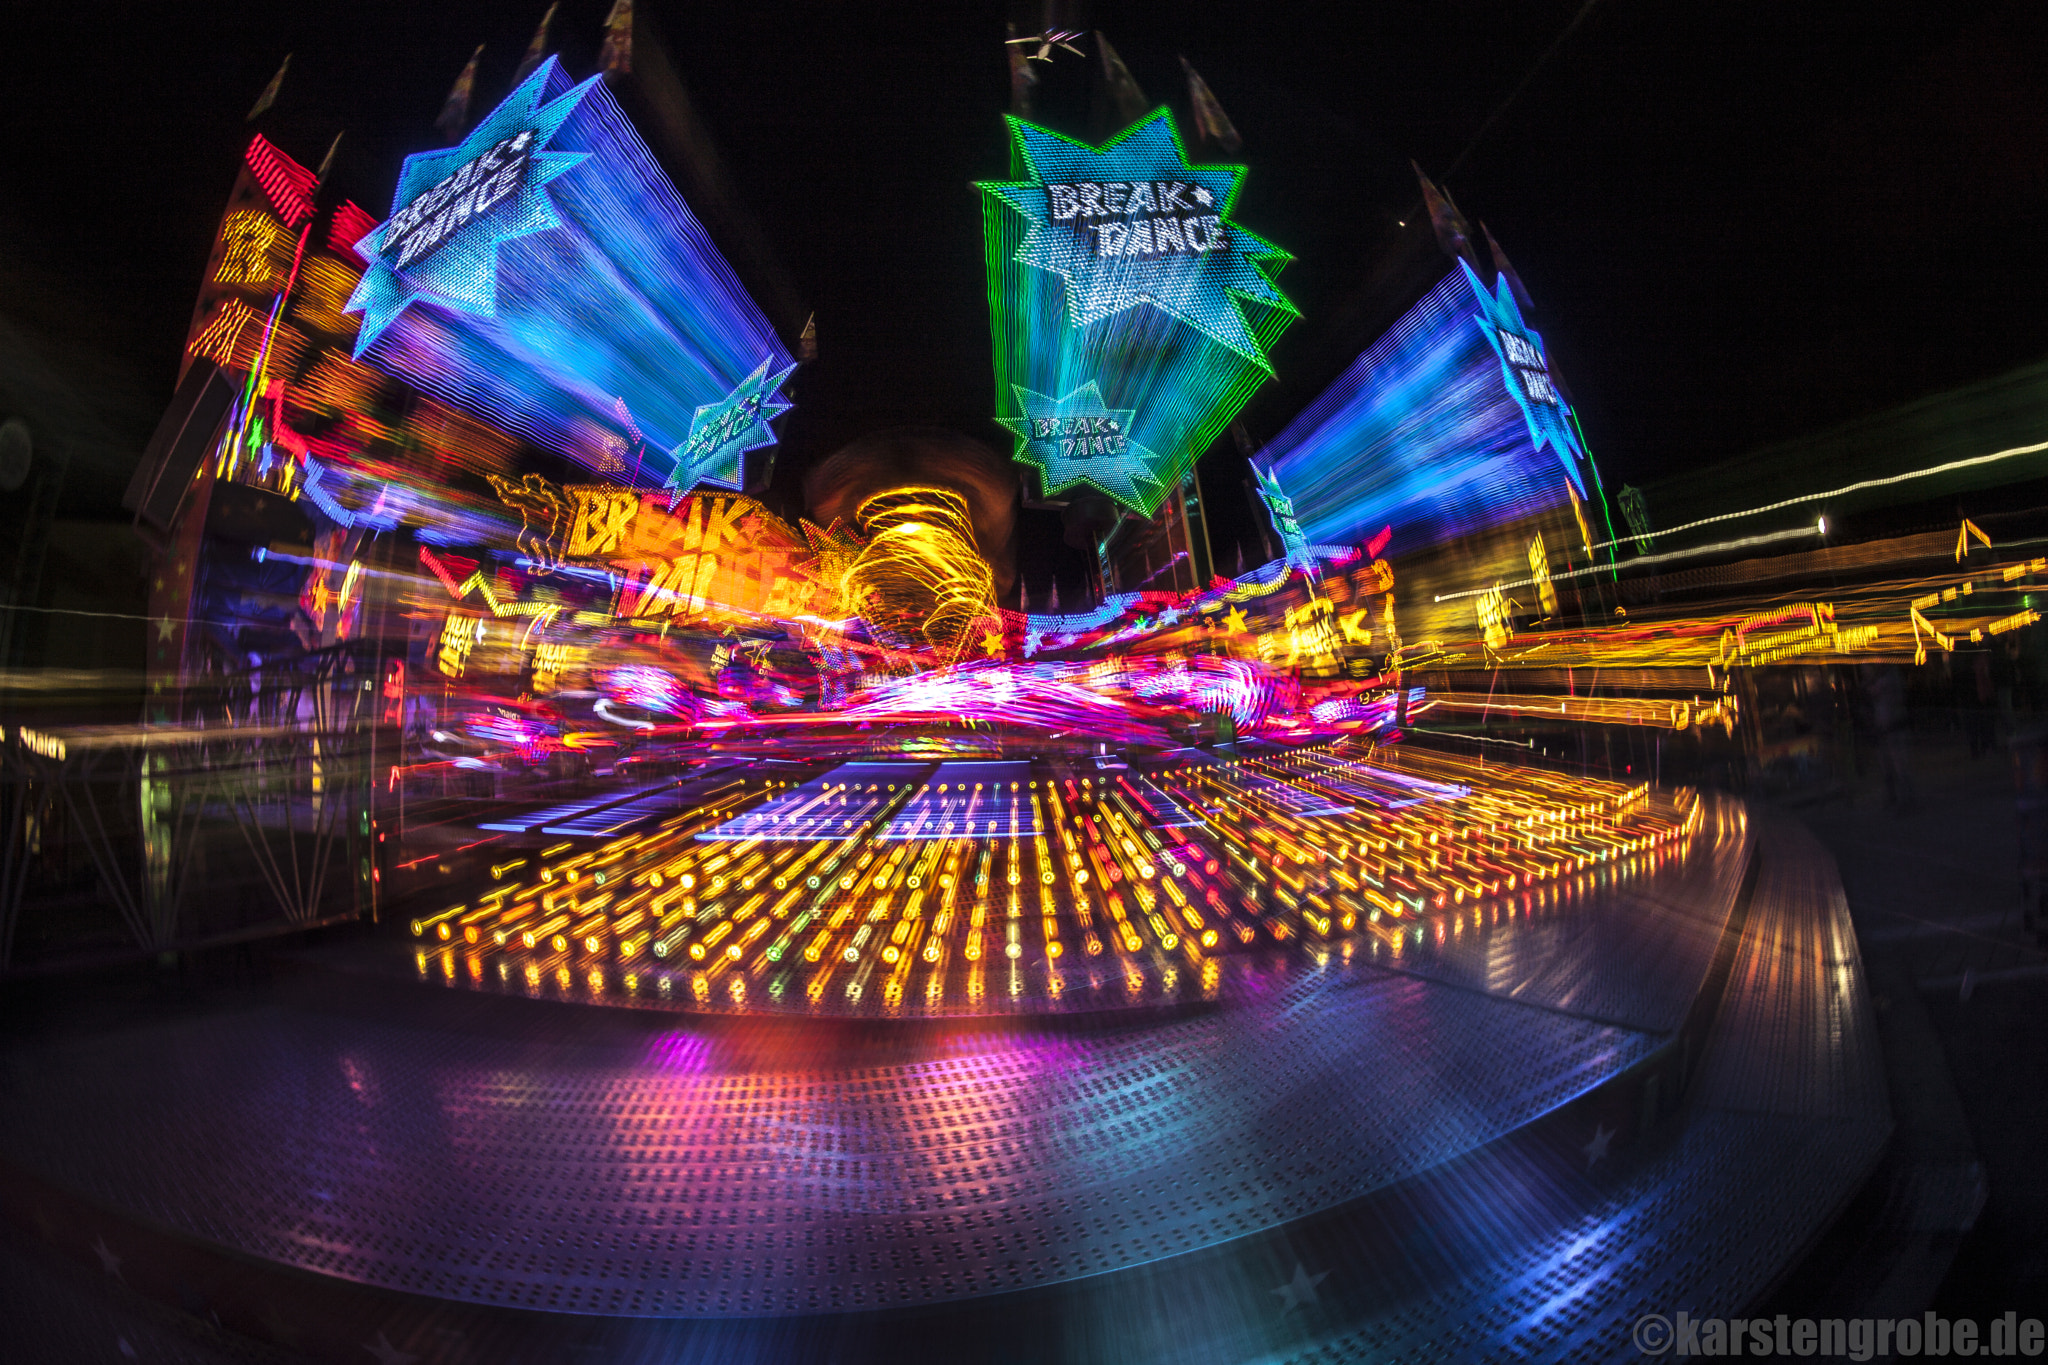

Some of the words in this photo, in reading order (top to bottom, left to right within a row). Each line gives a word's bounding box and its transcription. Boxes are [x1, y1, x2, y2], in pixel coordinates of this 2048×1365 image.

[382, 139, 510, 252] BREAK
[1048, 181, 1194, 219] BREAK
[1089, 215, 1228, 256] DANCE
[1033, 417, 1109, 438] BREAK
[1059, 435, 1126, 457] DANCE
[568, 488, 760, 555] BREAK
[445, 614, 476, 642] BREAK
[1301, 615, 1334, 647] BREAK
[440, 631, 473, 656] DANCE
[536, 643, 569, 664] BREAK
[1305, 634, 1343, 657] DANCE
[532, 658, 571, 675] DANCE
[1088, 656, 1125, 677] BREAK
